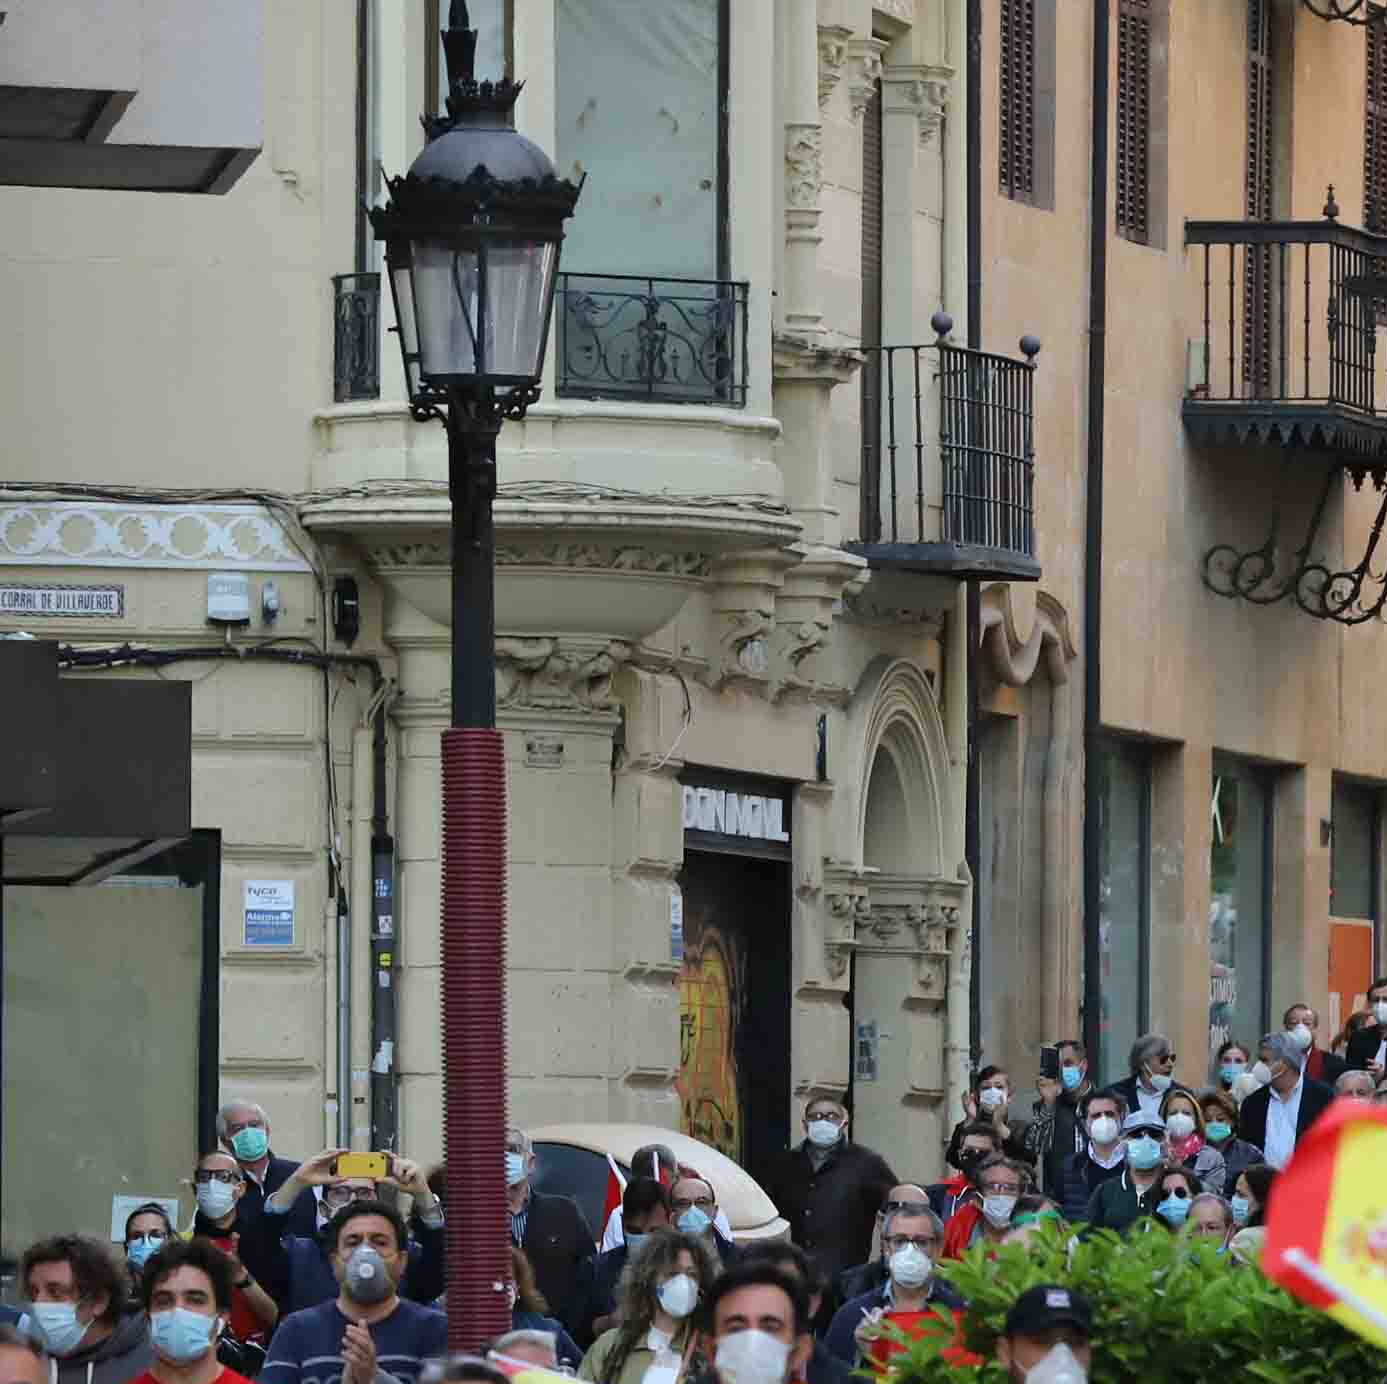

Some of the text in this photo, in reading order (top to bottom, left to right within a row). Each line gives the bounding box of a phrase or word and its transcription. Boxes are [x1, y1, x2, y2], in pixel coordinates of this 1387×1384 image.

[1, 591, 114, 611] CORRAL DE VILLAVERDE
